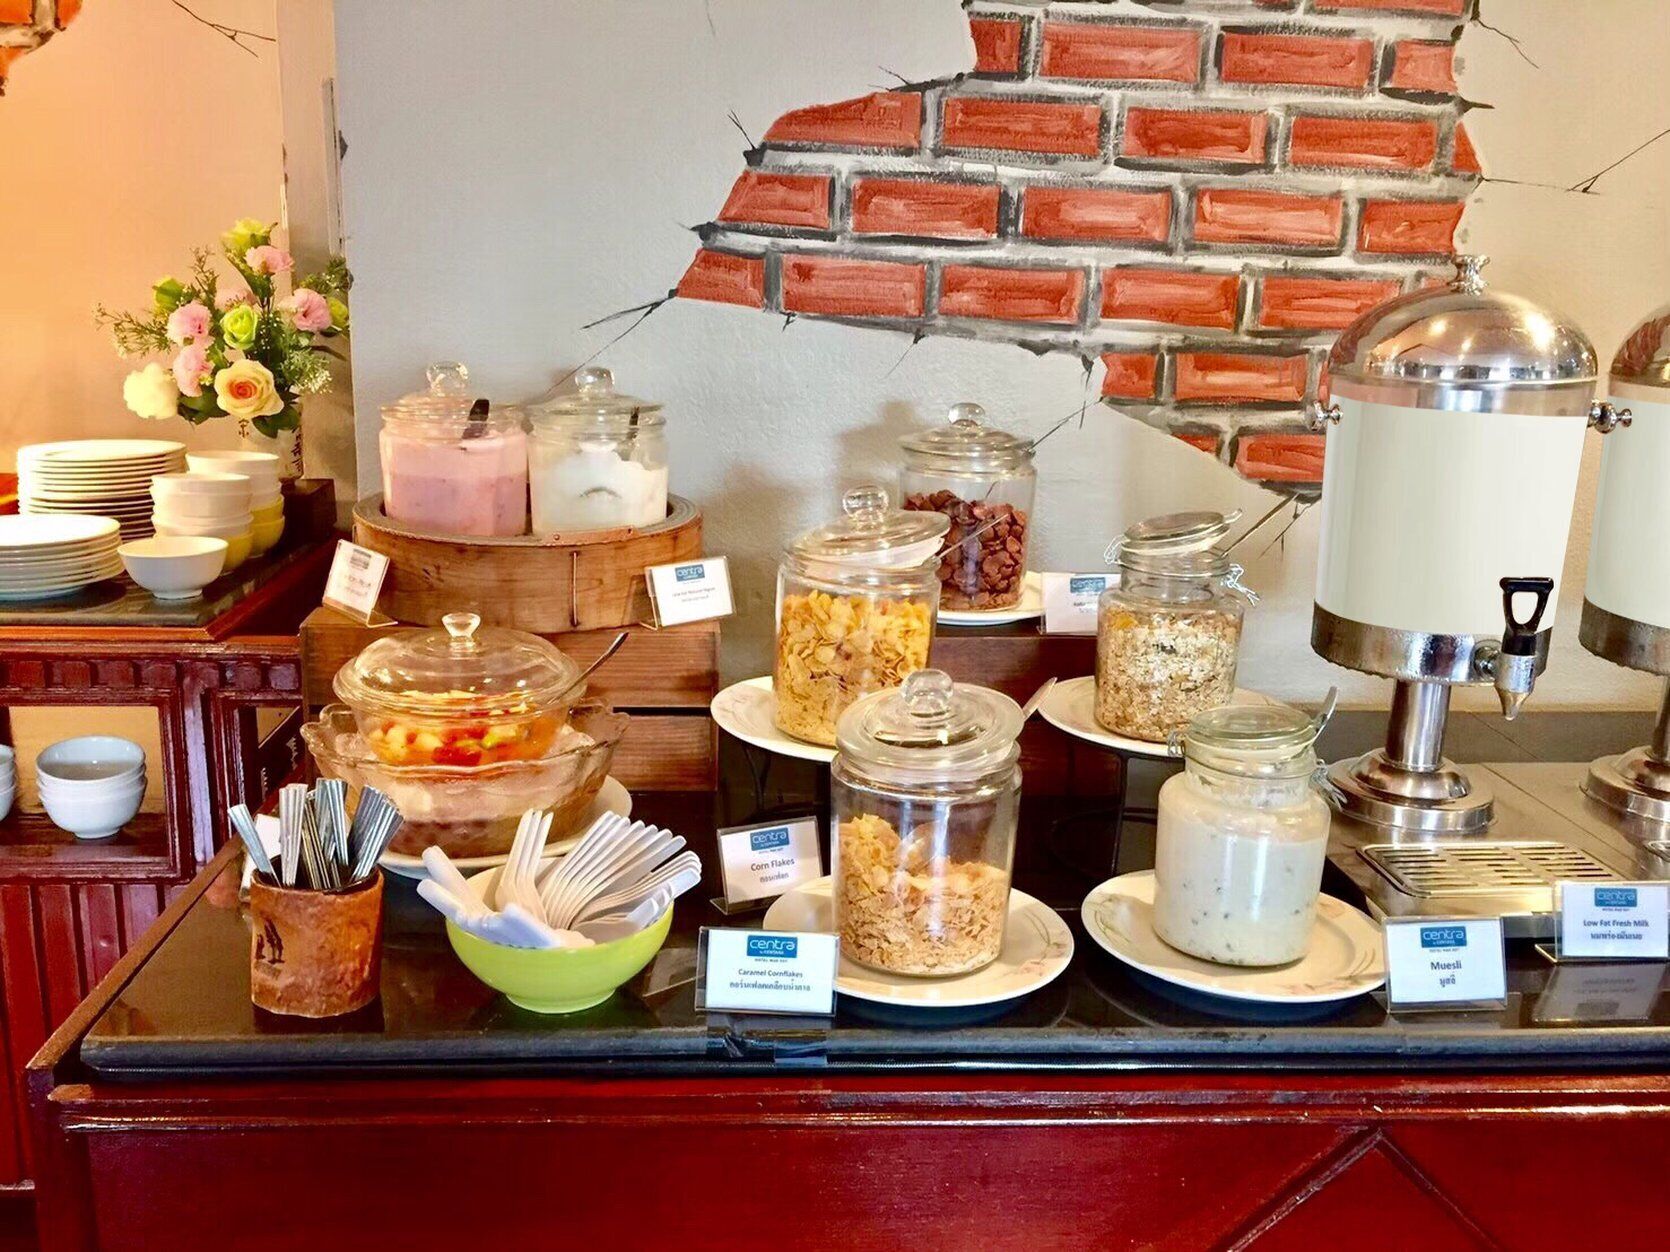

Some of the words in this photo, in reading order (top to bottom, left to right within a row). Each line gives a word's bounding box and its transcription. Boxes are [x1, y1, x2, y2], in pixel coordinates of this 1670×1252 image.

[752, 831, 787, 844] centra
[750, 862, 770, 872] Corn
[771, 858, 795, 869] Flakes
[1583, 919, 1598, 927] Low
[1600, 919, 1611, 927] Fat
[1612, 919, 1632, 927] Fresh
[1633, 919, 1649, 927] Milk
[1423, 928, 1465, 941] centra
[749, 939, 796, 951] centra
[1430, 960, 1462, 971] Muesli
[738, 968, 767, 977] Caramel
[767, 970, 804, 979] Cornflakes
